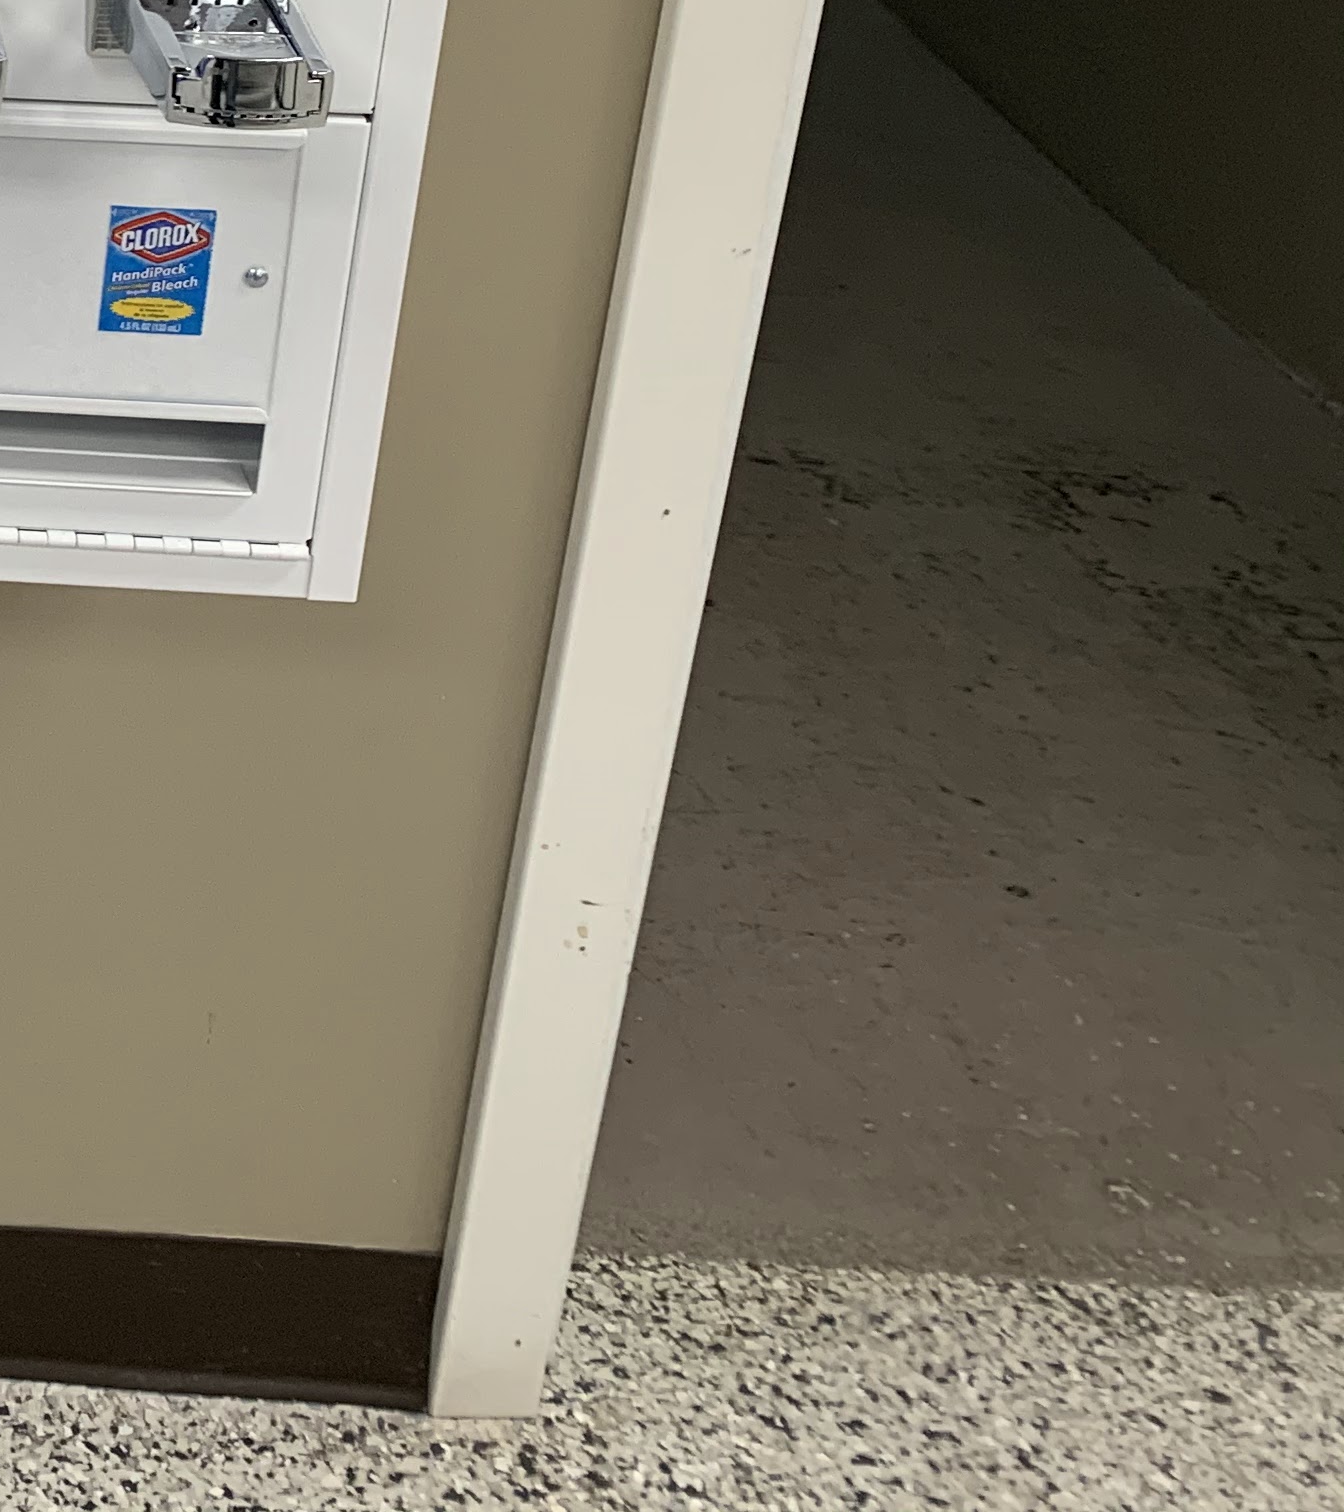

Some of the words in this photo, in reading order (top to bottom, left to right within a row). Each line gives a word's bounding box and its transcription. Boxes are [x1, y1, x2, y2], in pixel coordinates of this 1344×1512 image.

[120, 222, 201, 252] CLOROX
[112, 263, 186, 282] HandiPack
[152, 276, 198, 292] Bleach
